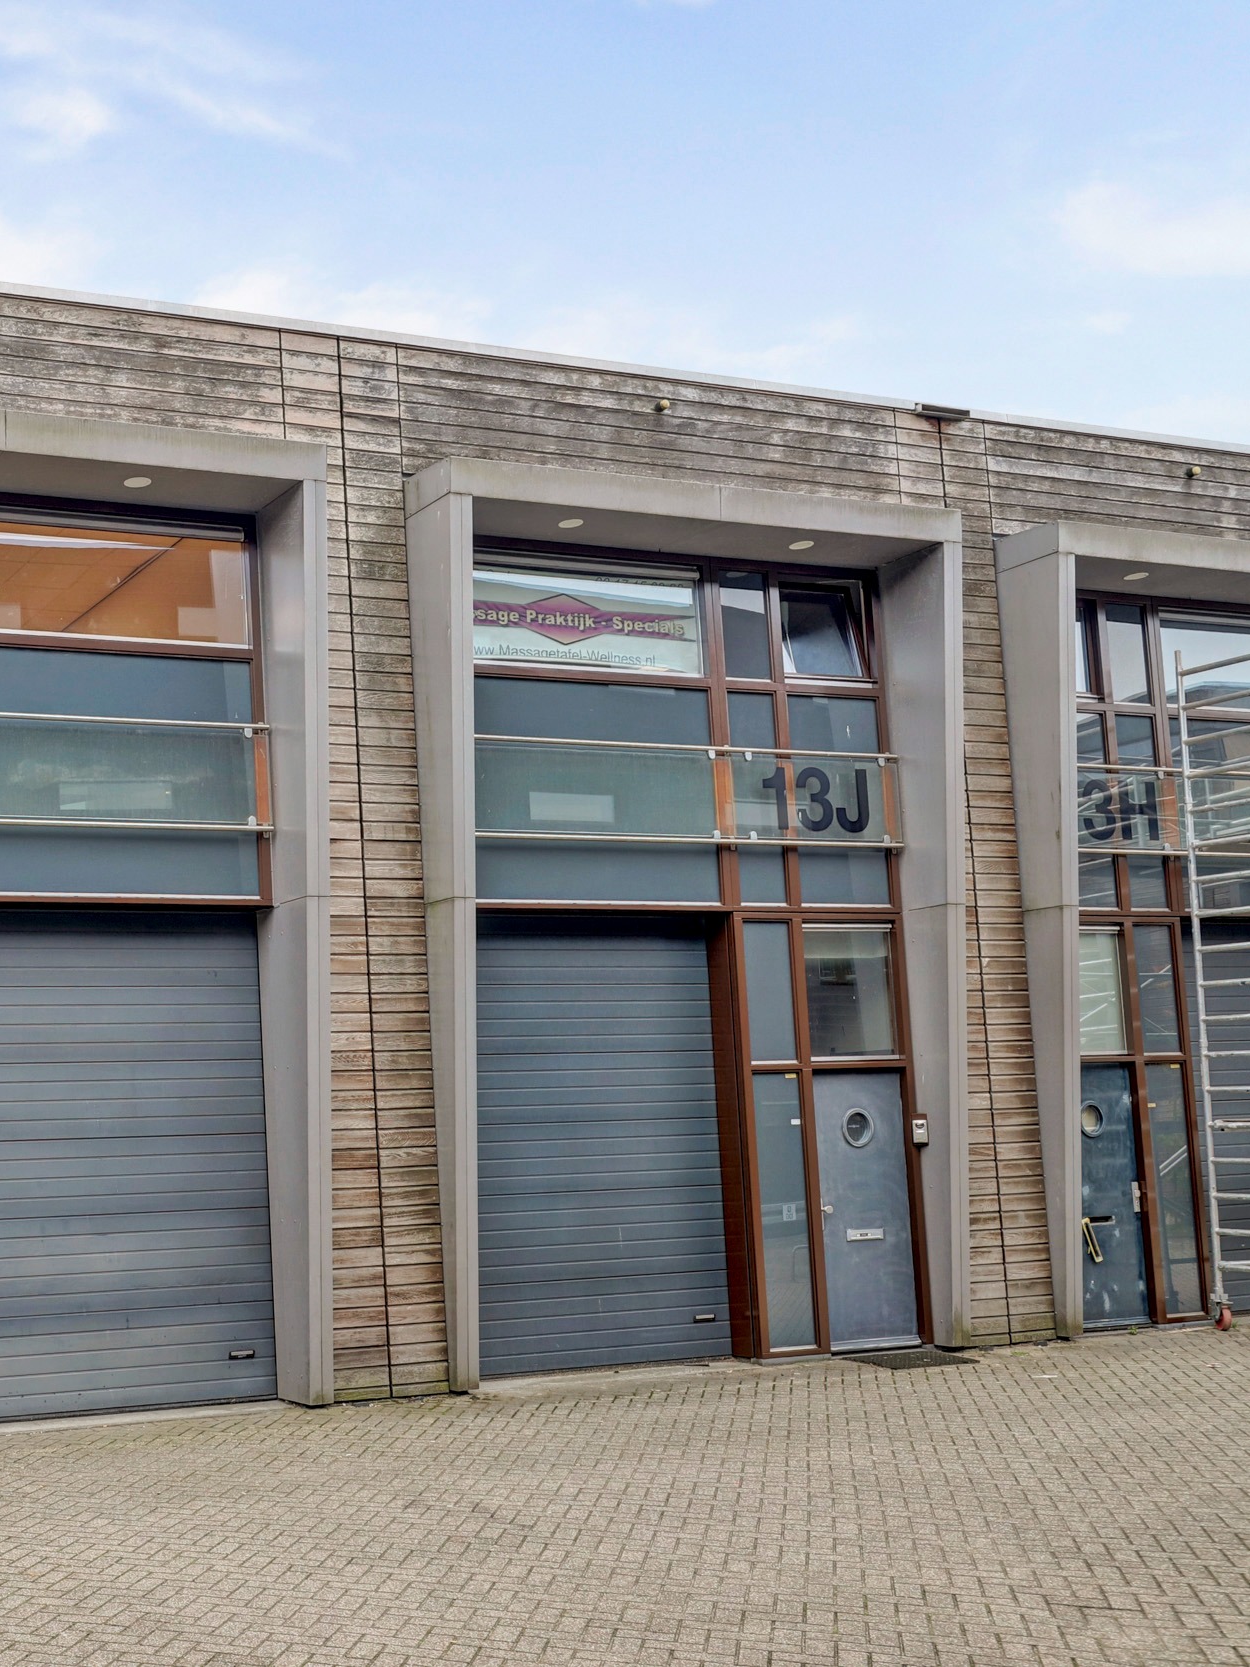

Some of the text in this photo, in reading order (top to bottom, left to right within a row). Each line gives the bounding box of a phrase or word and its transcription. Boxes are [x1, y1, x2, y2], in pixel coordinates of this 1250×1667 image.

[473, 608, 520, 625] sage
[526, 608, 595, 631] Praktijk
[612, 615, 685, 635] Specials
[762, 766, 870, 833] 13J
[1082, 779, 1160, 841] 3H
